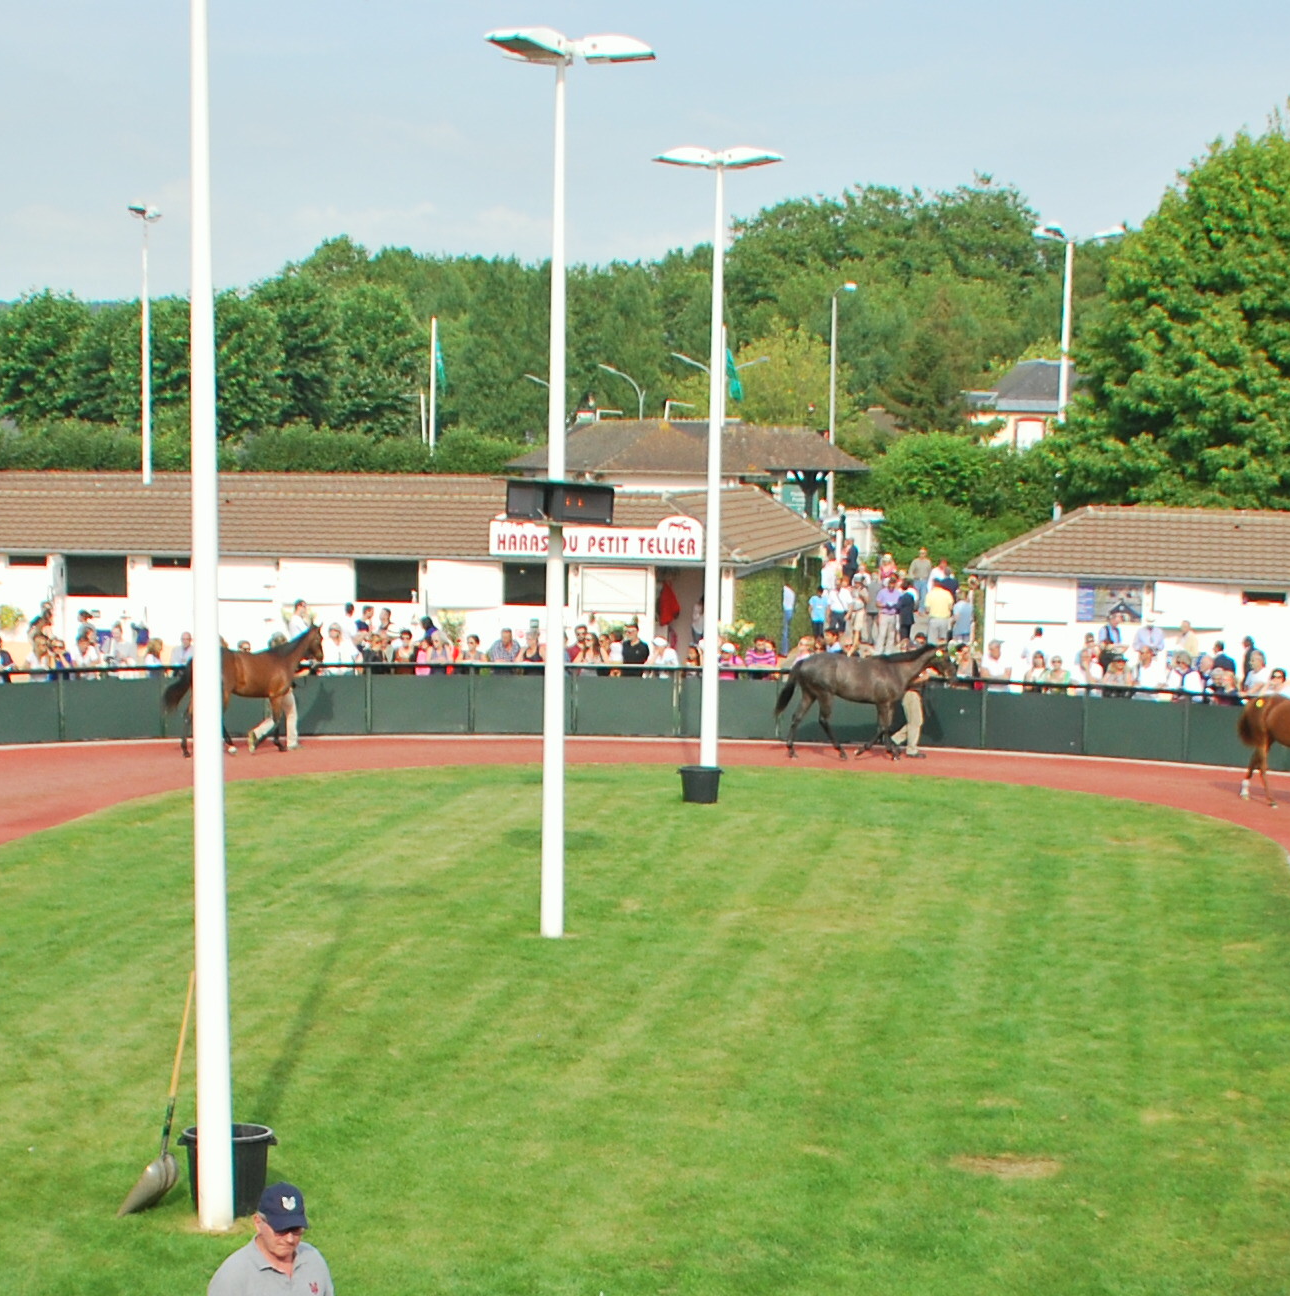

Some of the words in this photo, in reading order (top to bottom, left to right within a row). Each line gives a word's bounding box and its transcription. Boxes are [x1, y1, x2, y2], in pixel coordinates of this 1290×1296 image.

[497, 533, 550, 552] HARAS
[587, 535, 629, 553] PETIT
[638, 537, 696, 555] TELLIER
